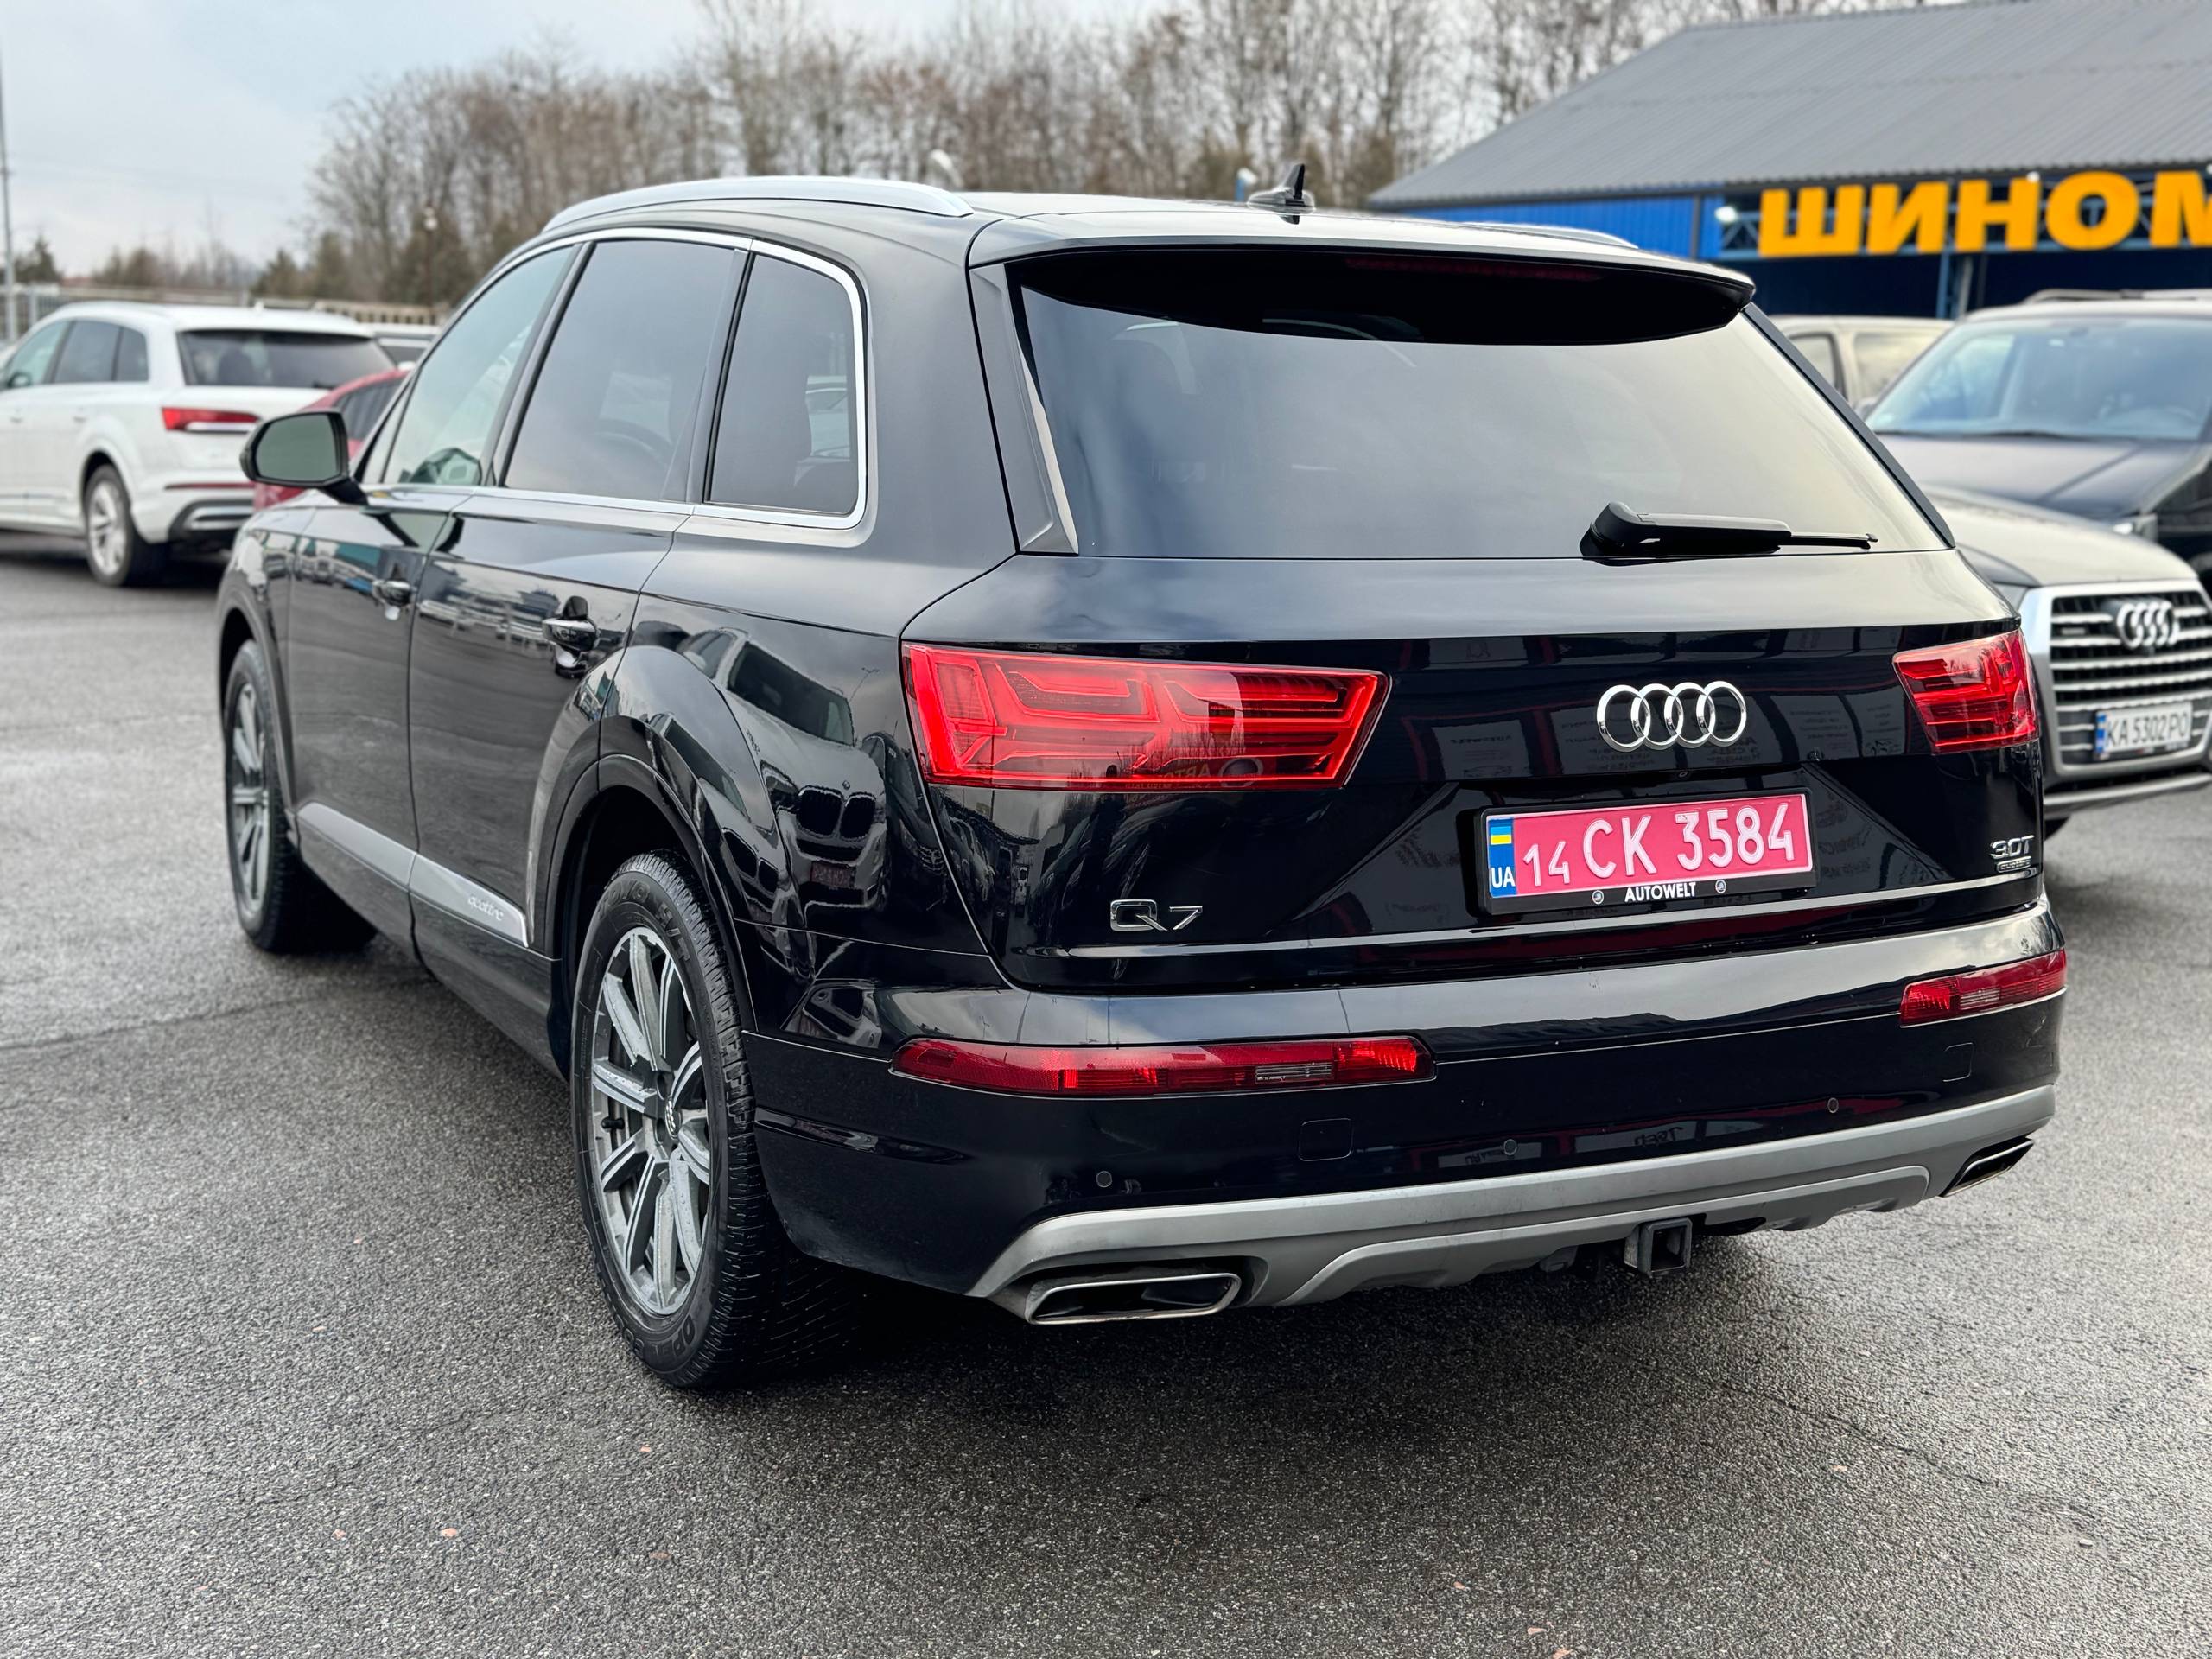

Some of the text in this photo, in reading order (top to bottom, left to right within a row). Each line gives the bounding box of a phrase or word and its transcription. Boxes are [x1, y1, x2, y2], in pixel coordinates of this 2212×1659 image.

[1522, 803, 1796, 887] 14 CK 3584
[1491, 867, 1516, 889] UA
[1624, 881, 1697, 903] AUTOWELT
[1110, 899, 1203, 931] Q7
